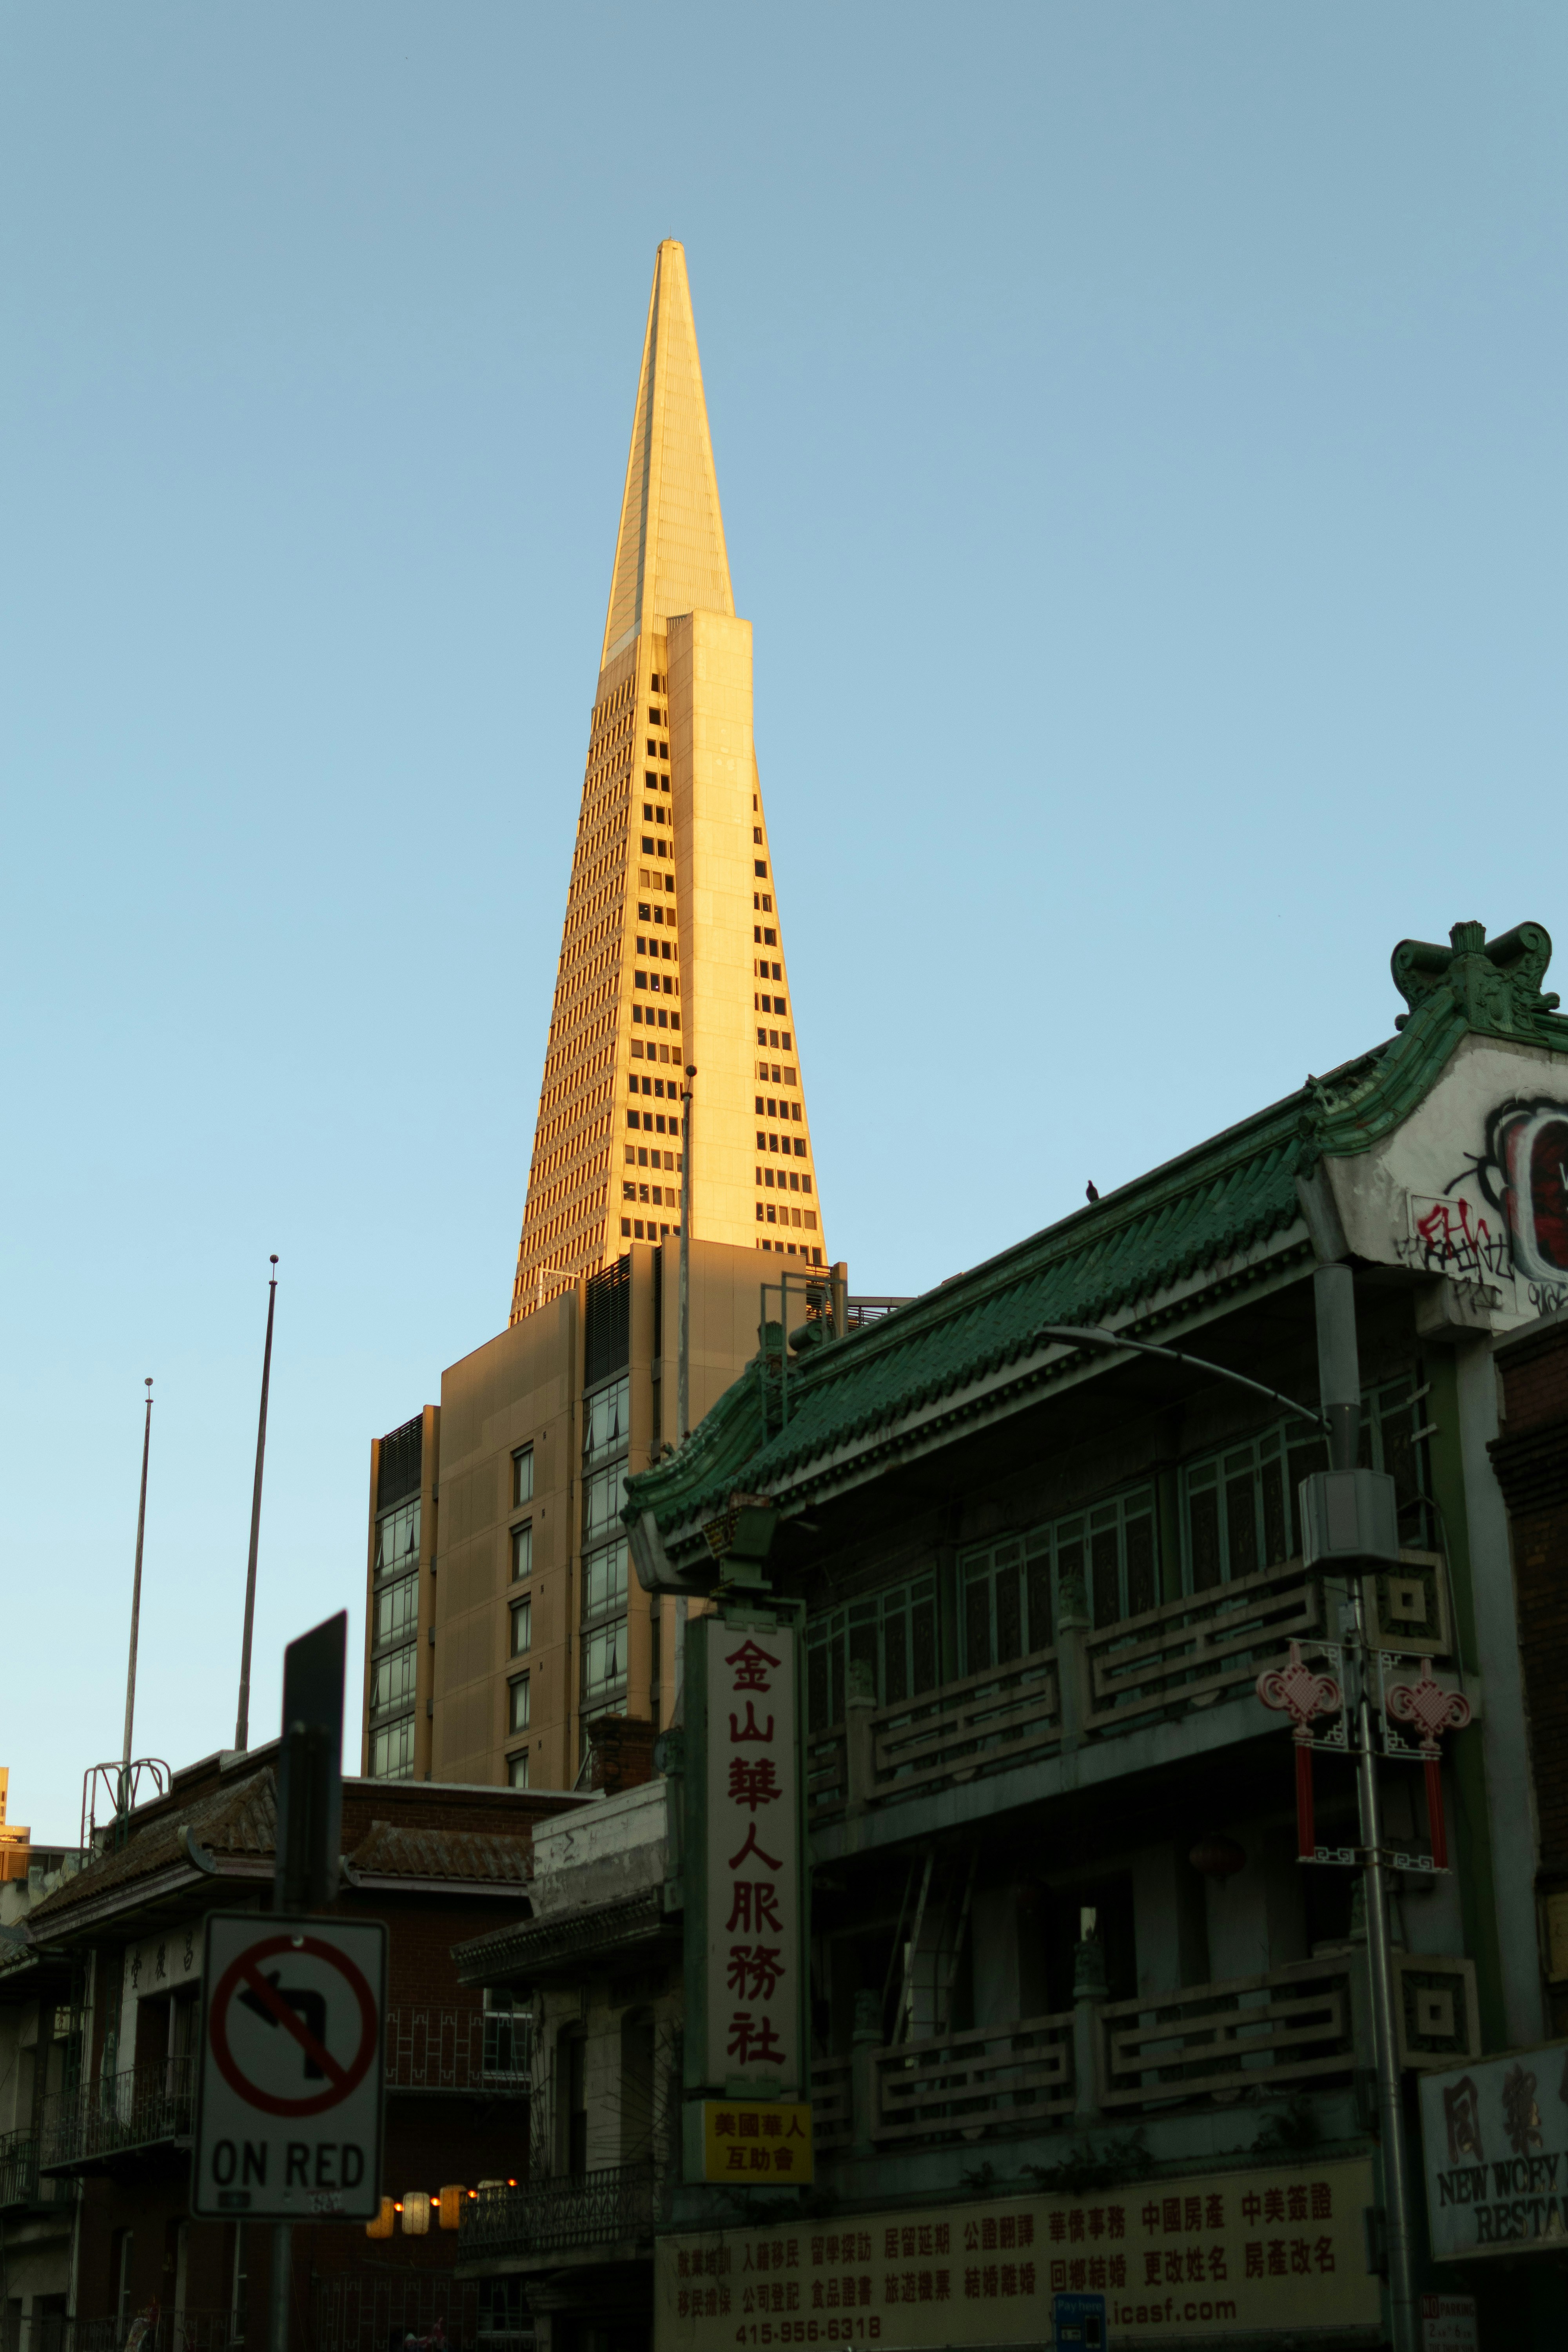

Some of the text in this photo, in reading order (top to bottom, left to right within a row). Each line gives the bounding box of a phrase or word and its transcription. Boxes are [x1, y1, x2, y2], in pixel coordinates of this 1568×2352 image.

[725, 1640, 786, 2065] 金山華人服務社
[715, 2112, 806, 2138] 美國華人
[213, 2140, 364, 2188] ON RED
[726, 2146, 793, 2171] 互助會
[1437, 2164, 1488, 2206] NEW
[742, 2239, 799, 2272] 入籍移民
[884, 2223, 949, 2259] 居留延期
[1048, 2205, 1125, 2244] 華僑事務
[1142, 2193, 1225, 2235] 中國房產
[742, 2281, 800, 2313] 公司登記
[811, 2276, 872, 2308] 食品證書
[884, 2269, 951, 2303] 旅遊機票
[965, 2261, 1036, 2299] 結婚離婚
[1050, 2254, 1126, 2292] 回鄉結婚
[1143, 2245, 1227, 2286] 更改姓名
[1245, 2235, 1335, 2279] 房產改名
[1058, 2299, 1077, 2314] Pay
[1423, 2298, 1474, 2317] NO PARKING
